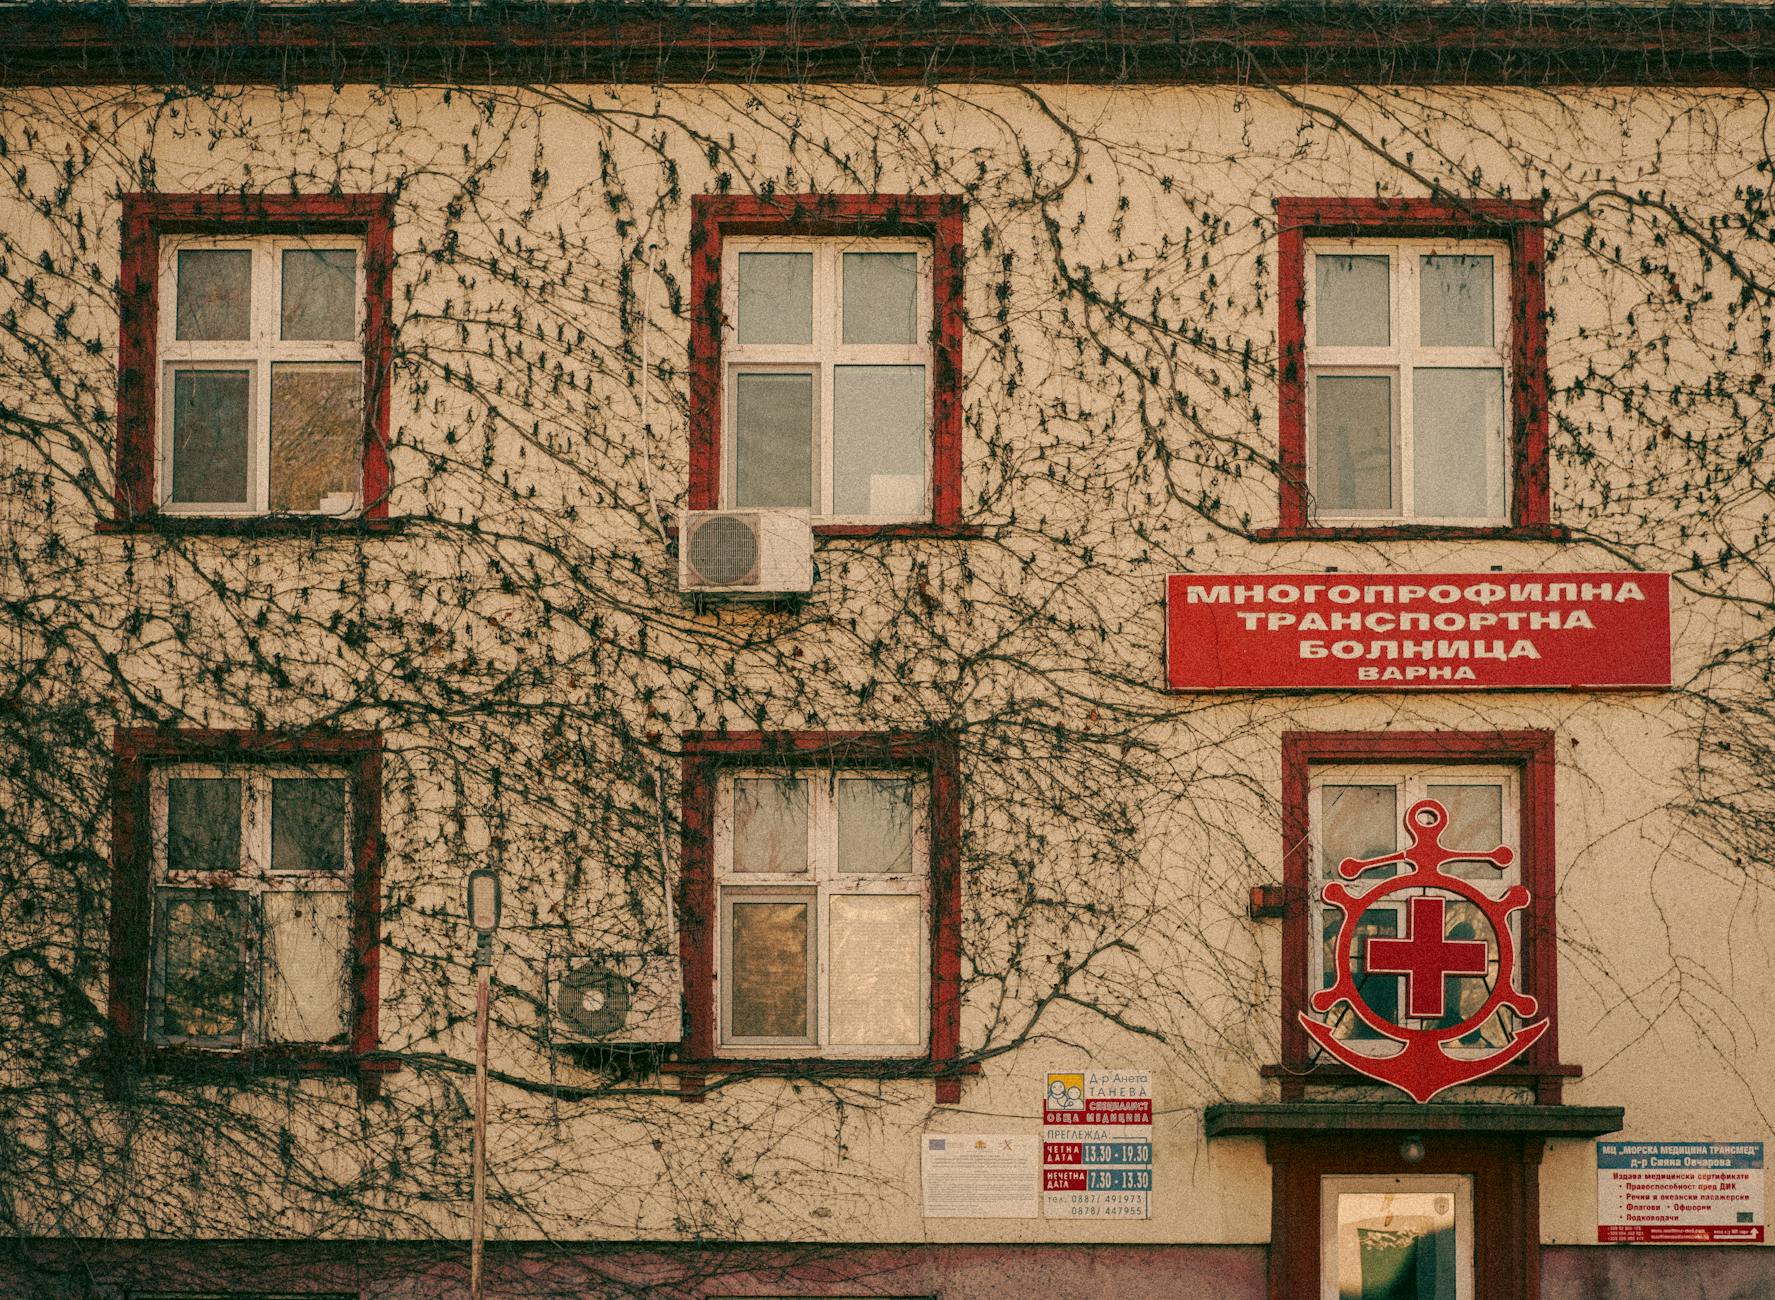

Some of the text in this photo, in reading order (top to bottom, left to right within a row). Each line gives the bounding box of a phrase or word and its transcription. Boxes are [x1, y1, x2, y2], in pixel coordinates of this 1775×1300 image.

[1187, 582, 1645, 606] МНОГОПРОФИЛНА
[1237, 610, 1597, 632] ТРАНСПОРТНА
[1299, 639, 1541, 661] БОЛНИЦА
[1358, 666, 1476, 681] ВАРНА
[1090, 1073, 1148, 1085] Д-р Анета
[1089, 1087, 1147, 1097] ТАНЕВА
[1089, 1101, 1149, 1111] СПЕЦИАЛИСТ
[1046, 1113, 1149, 1123] ОБЩА МЕДИЦИНА
[1047, 1146, 1080, 1154] ЧЕТНА
[1084, 1146, 1111, 1162] 13.30
[1122, 1146, 1149, 1162] 19.30
[1603, 1146, 1617, 1155] МЦ
[1660, 1146, 1708, 1155] МЕДИЦИНА
[1047, 1154, 1073, 1162] ДАТА
[1631, 1158, 1648, 1168] д-р
[1684, 1157, 1731, 1168] Овчарова
[1047, 1172, 1085, 1180] НЕЧЕТНА
[1090, 1172, 1111, 1188] 7.30
[1122, 1172, 1149, 1188] 13.30
[1613, 1173, 1642, 1181] Издава
[1698, 1173, 1750, 1182] сертификати
[1047, 1181, 1069, 1189] ДАТА
[1626, 1183, 1695, 1192] Правоспособност
[1698, 1184, 1717, 1192] пред
[1700, 1194, 1750, 1202] пасажерски
[1626, 1203, 1712, 1212] Флагови Офшорни
